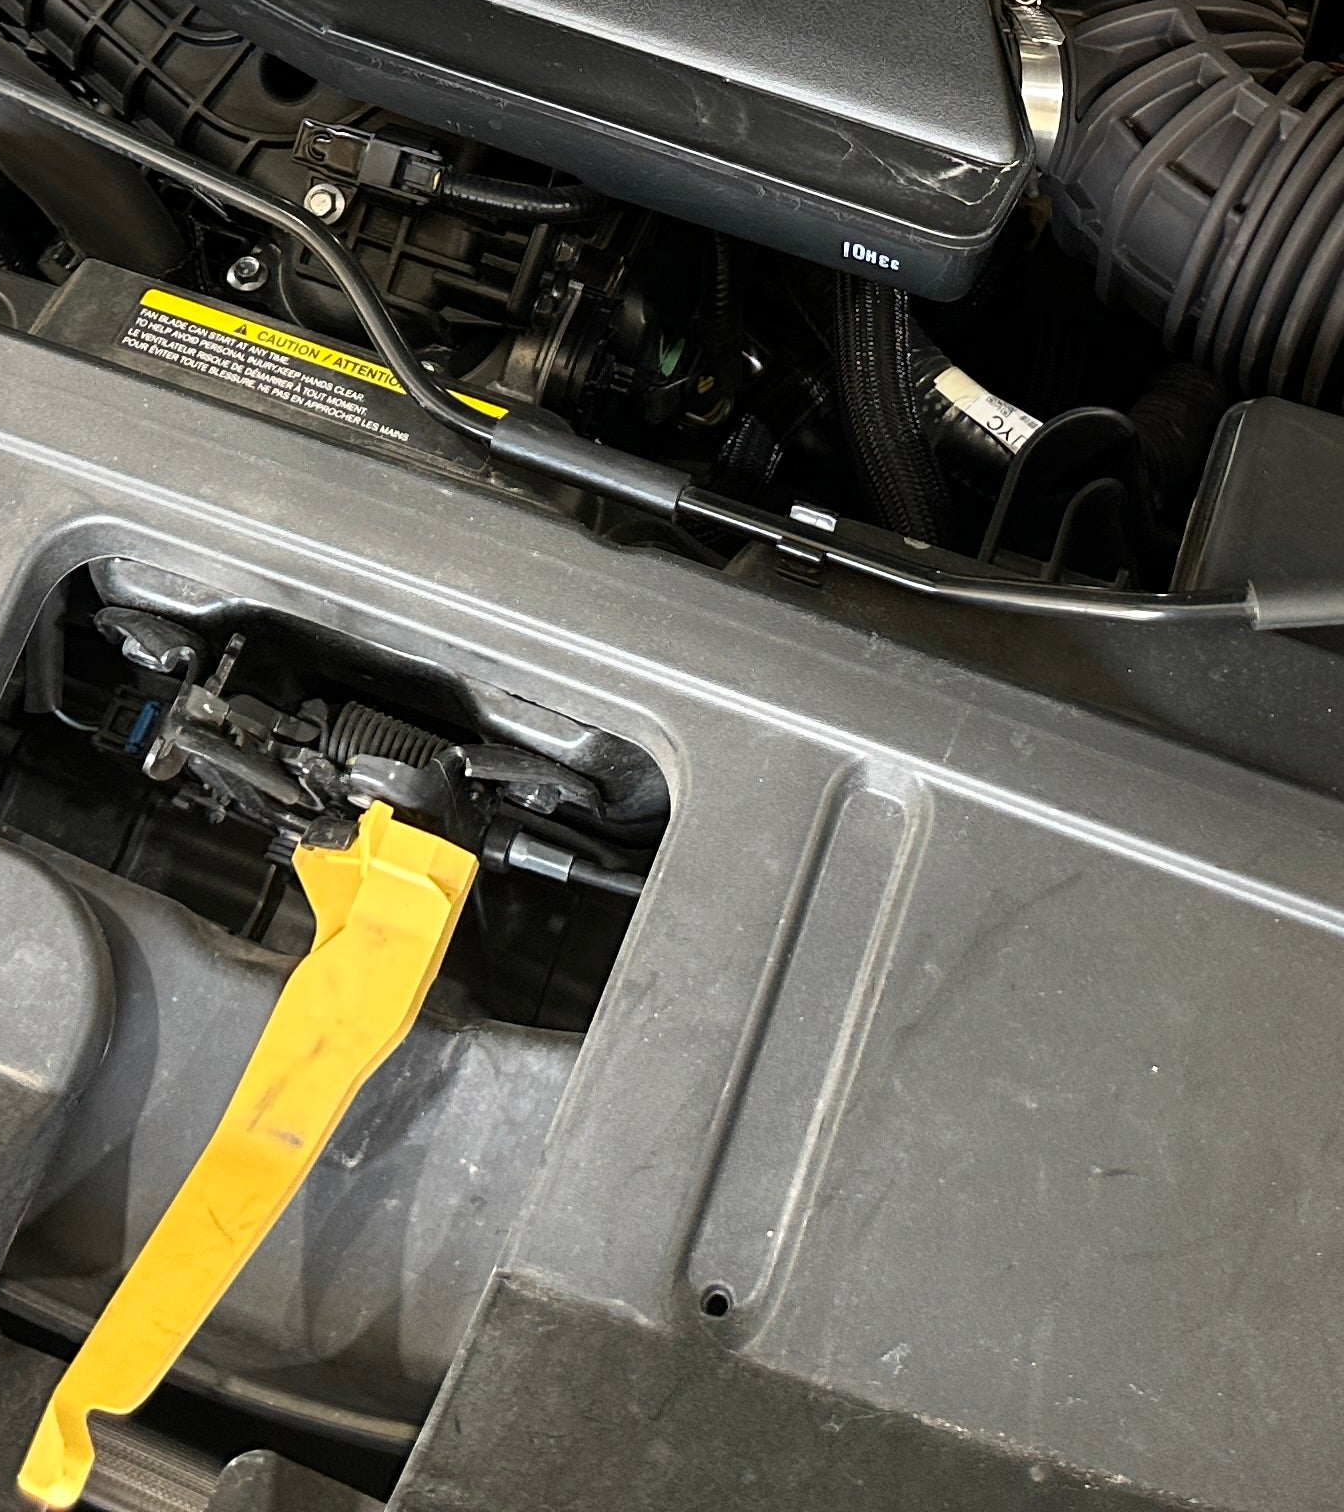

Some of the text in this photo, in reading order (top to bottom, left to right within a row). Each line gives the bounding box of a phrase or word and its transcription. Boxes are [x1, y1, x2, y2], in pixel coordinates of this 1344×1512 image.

[127, 327, 141, 337] LE
[139, 331, 197, 356] VENTILATEUR
[195, 350, 231, 368] RISQUE
[229, 362, 245, 373] DE
[243, 365, 295, 390] DÉMARRER
[292, 381, 303, 393] À
[301, 386, 326, 401] TOUT
[134, 317, 149, 327] TO
[147, 321, 173, 335] HELP
[170, 329, 200, 345] AVOID
[198, 339, 247, 361] PERSONAL
[299, 373, 334, 391] HANDS
[139, 308, 159, 320] FAN
[157, 314, 188, 330] BLADE
[186, 324, 208, 337] CAN
[207, 331, 237, 346] START
[235, 340, 248, 350] AT
[247, 344, 268, 357] ANY
[255, 330, 405, 388] CAUTION / ATTENTIO
[121, 336, 149, 351] POUR
[147, 343, 180, 361] ÉVITER
[178, 355, 209, 372] TOUTE
[256, 382, 271, 393] NE
[270, 387, 291, 400] PAS
[289, 394, 304, 405] EN
[303, 399, 363, 425] APPROCHER
[360, 418, 379, 431] LES
[379, 425, 409, 441] MAINS
